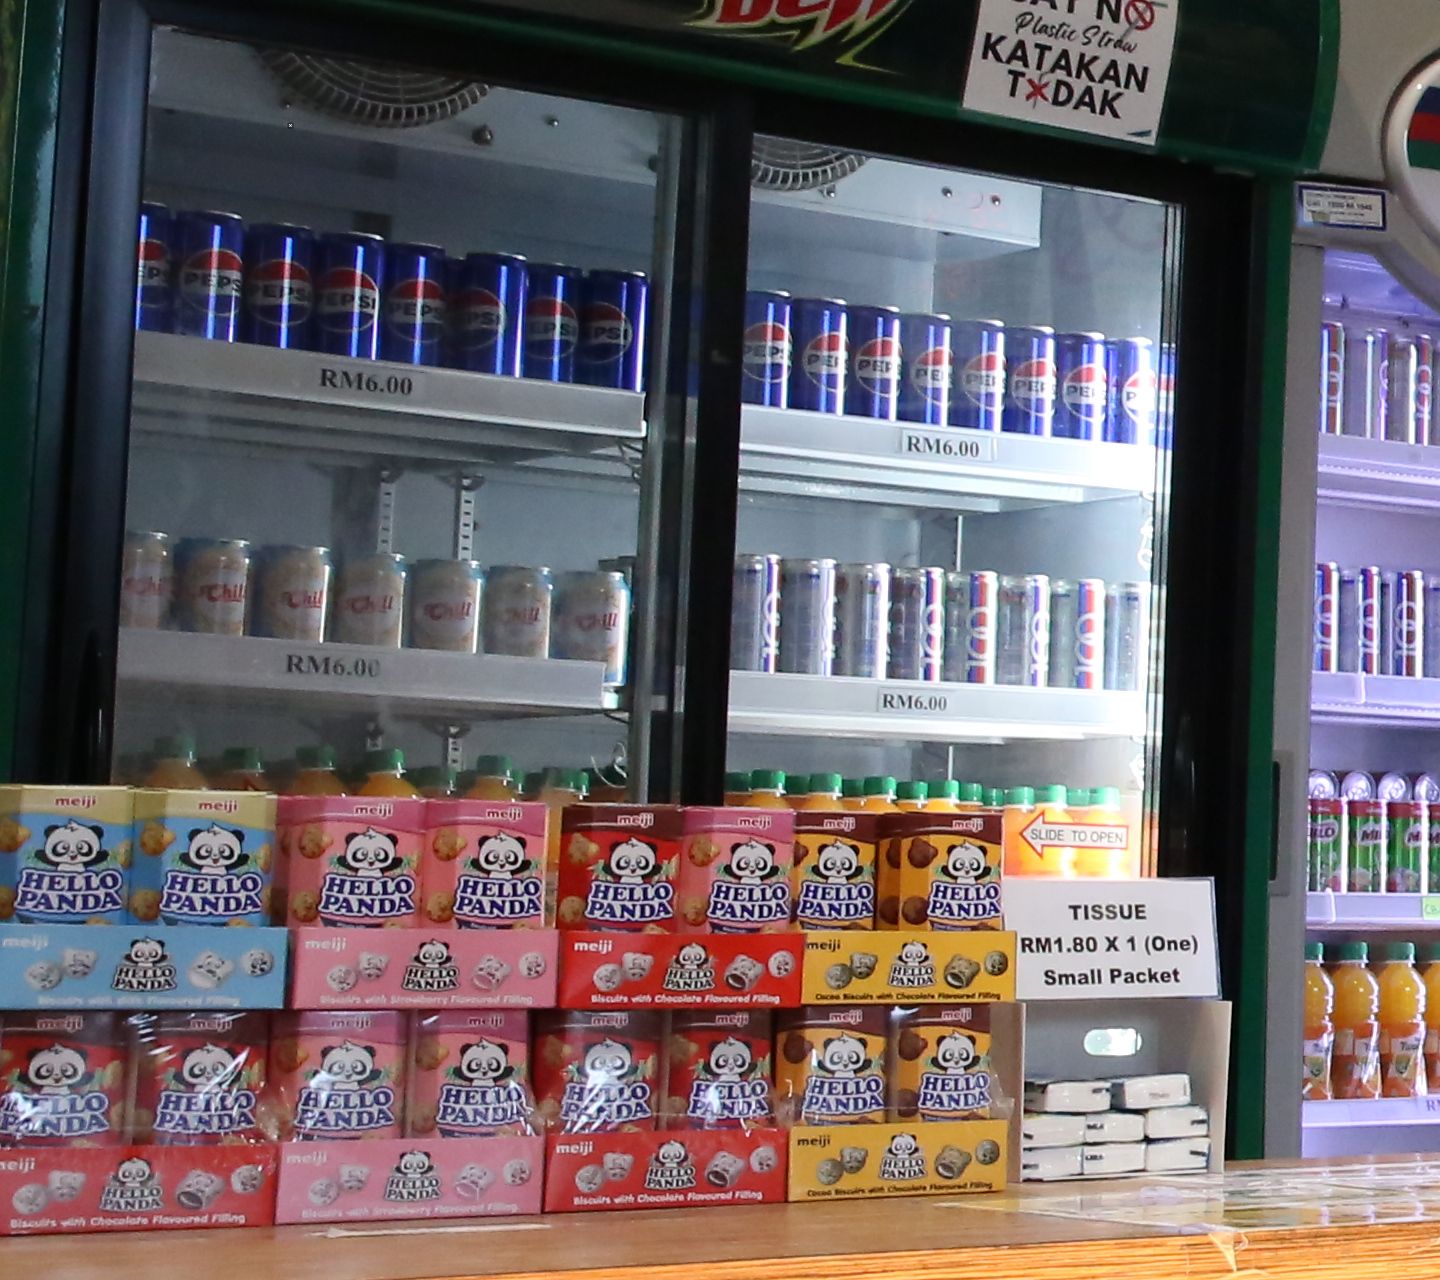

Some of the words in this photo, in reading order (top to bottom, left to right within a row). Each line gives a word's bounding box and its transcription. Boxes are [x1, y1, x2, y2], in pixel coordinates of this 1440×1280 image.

[1014, 12, 1078, 43] Plastic
[1080, 25, 1137, 55] Straw
[982, 33, 1148, 94] KATAKAN
[319, 368, 412, 395] RM6.00
[907, 435, 979, 458] RM6.00
[286, 654, 380, 678] RM6.00
[882, 693, 947, 711] RM6.00
[55, 796, 97, 808] meiji
[617, 813, 654, 828] meiji
[1031, 829, 1064, 840] SLIDE
[1072, 830, 1087, 841] TO
[1090, 831, 1123, 843] OPEN
[22, 872, 120, 891] HELLO
[17, 891, 121, 911] PANDA
[590, 883, 672, 902] HELLO
[802, 885, 873, 900] HELLO
[587, 901, 672, 920] PANDA
[800, 900, 873, 918] PANDA
[1069, 904, 1147, 920] TISSUE
[574, 940, 612, 953] meiji
[1021, 937, 1097, 953] RM1.80
[1105, 937, 1119, 951] X
[1127, 937, 1136, 951] 1
[1145, 935, 1198, 955] (One)
[1044, 969, 1102, 985] Small
[1110, 968, 1180, 984] Packet
